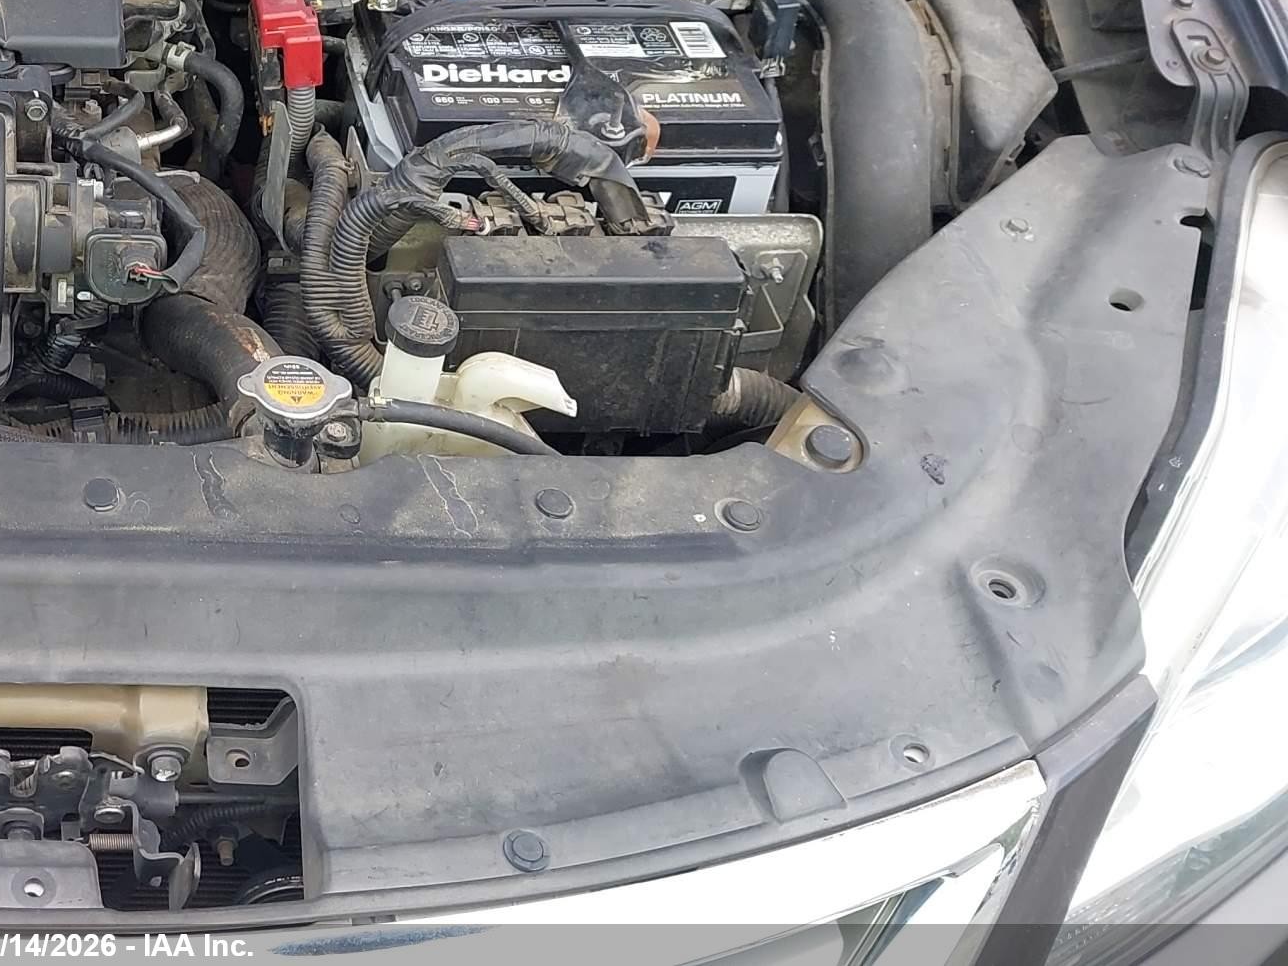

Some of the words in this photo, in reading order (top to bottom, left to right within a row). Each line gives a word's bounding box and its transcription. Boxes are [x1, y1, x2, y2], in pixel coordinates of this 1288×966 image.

[422, 63, 571, 84] DieHard
[642, 92, 742, 104] PLATINUM
[679, 201, 719, 211] AGM
